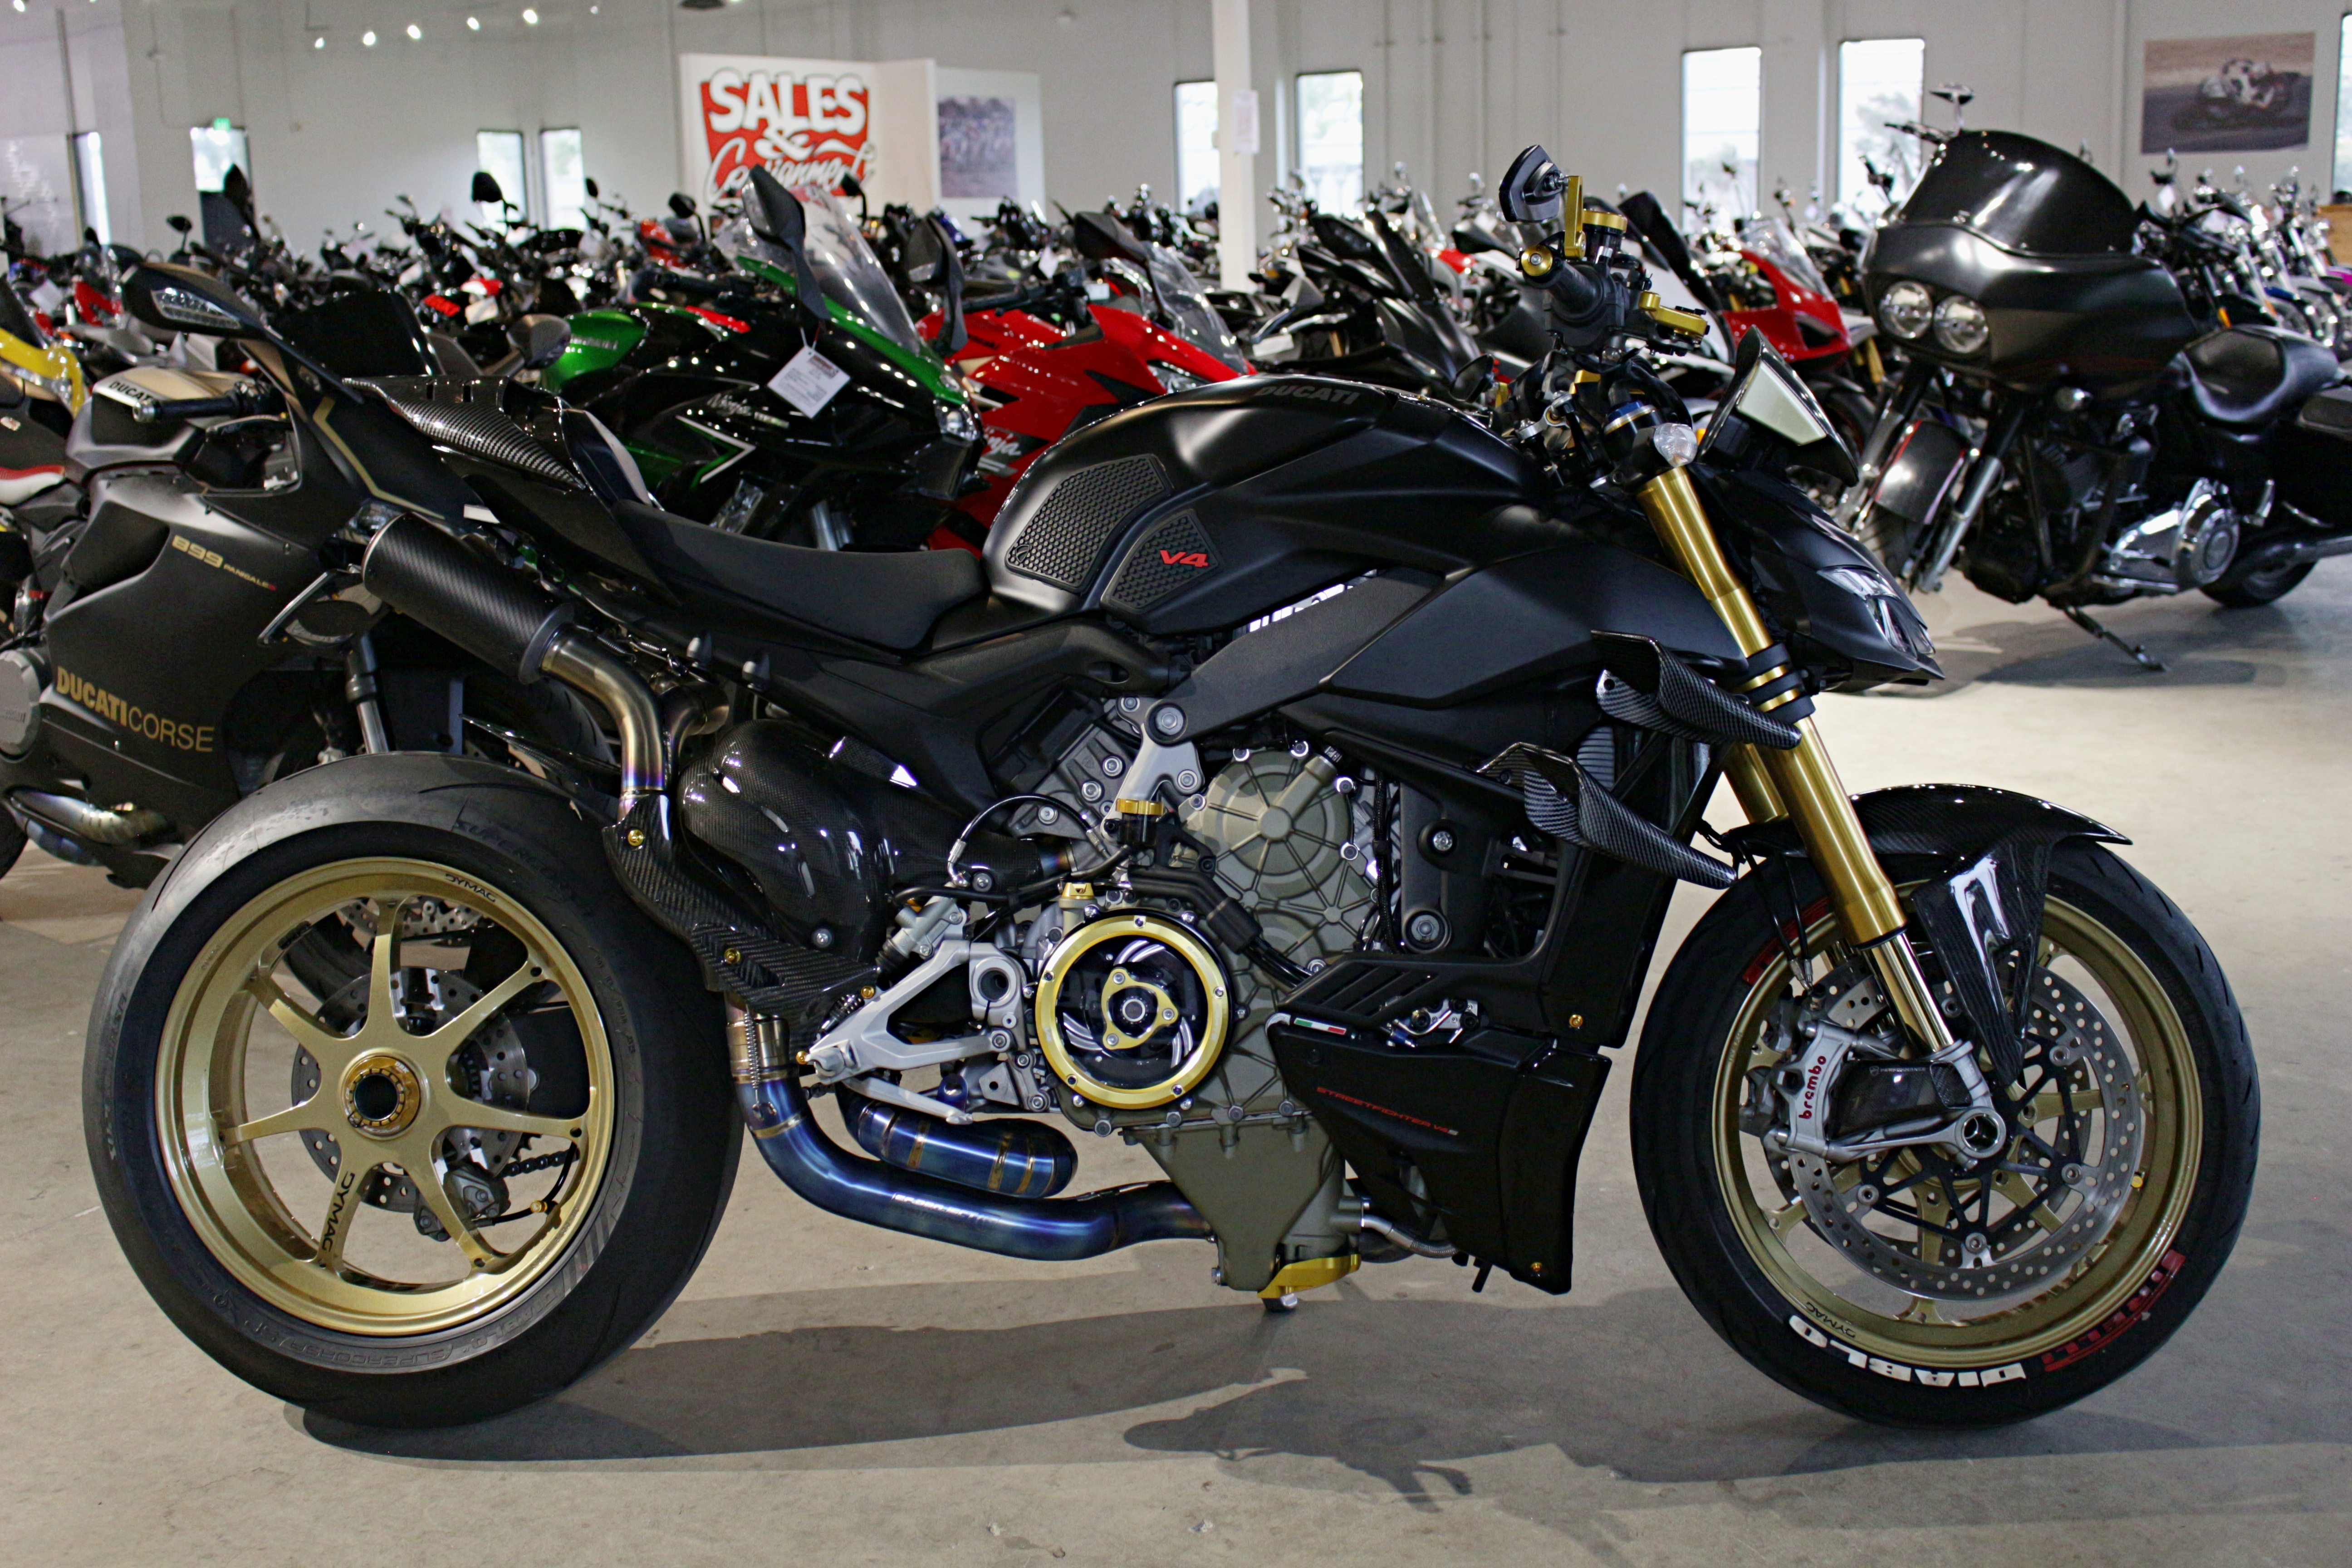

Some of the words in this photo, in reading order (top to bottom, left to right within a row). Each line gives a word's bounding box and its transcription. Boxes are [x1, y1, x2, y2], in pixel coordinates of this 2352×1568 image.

[709, 68, 867, 136] SALES
[1253, 386, 1360, 404] DUCATI
[172, 535, 223, 568] 899
[1160, 550, 1209, 568] V4
[1317, 1087, 1431, 1127] STREETFIGHTER
[1798, 1056, 1827, 1119] brembo
[1789, 1315, 2027, 1388] DIABLO
